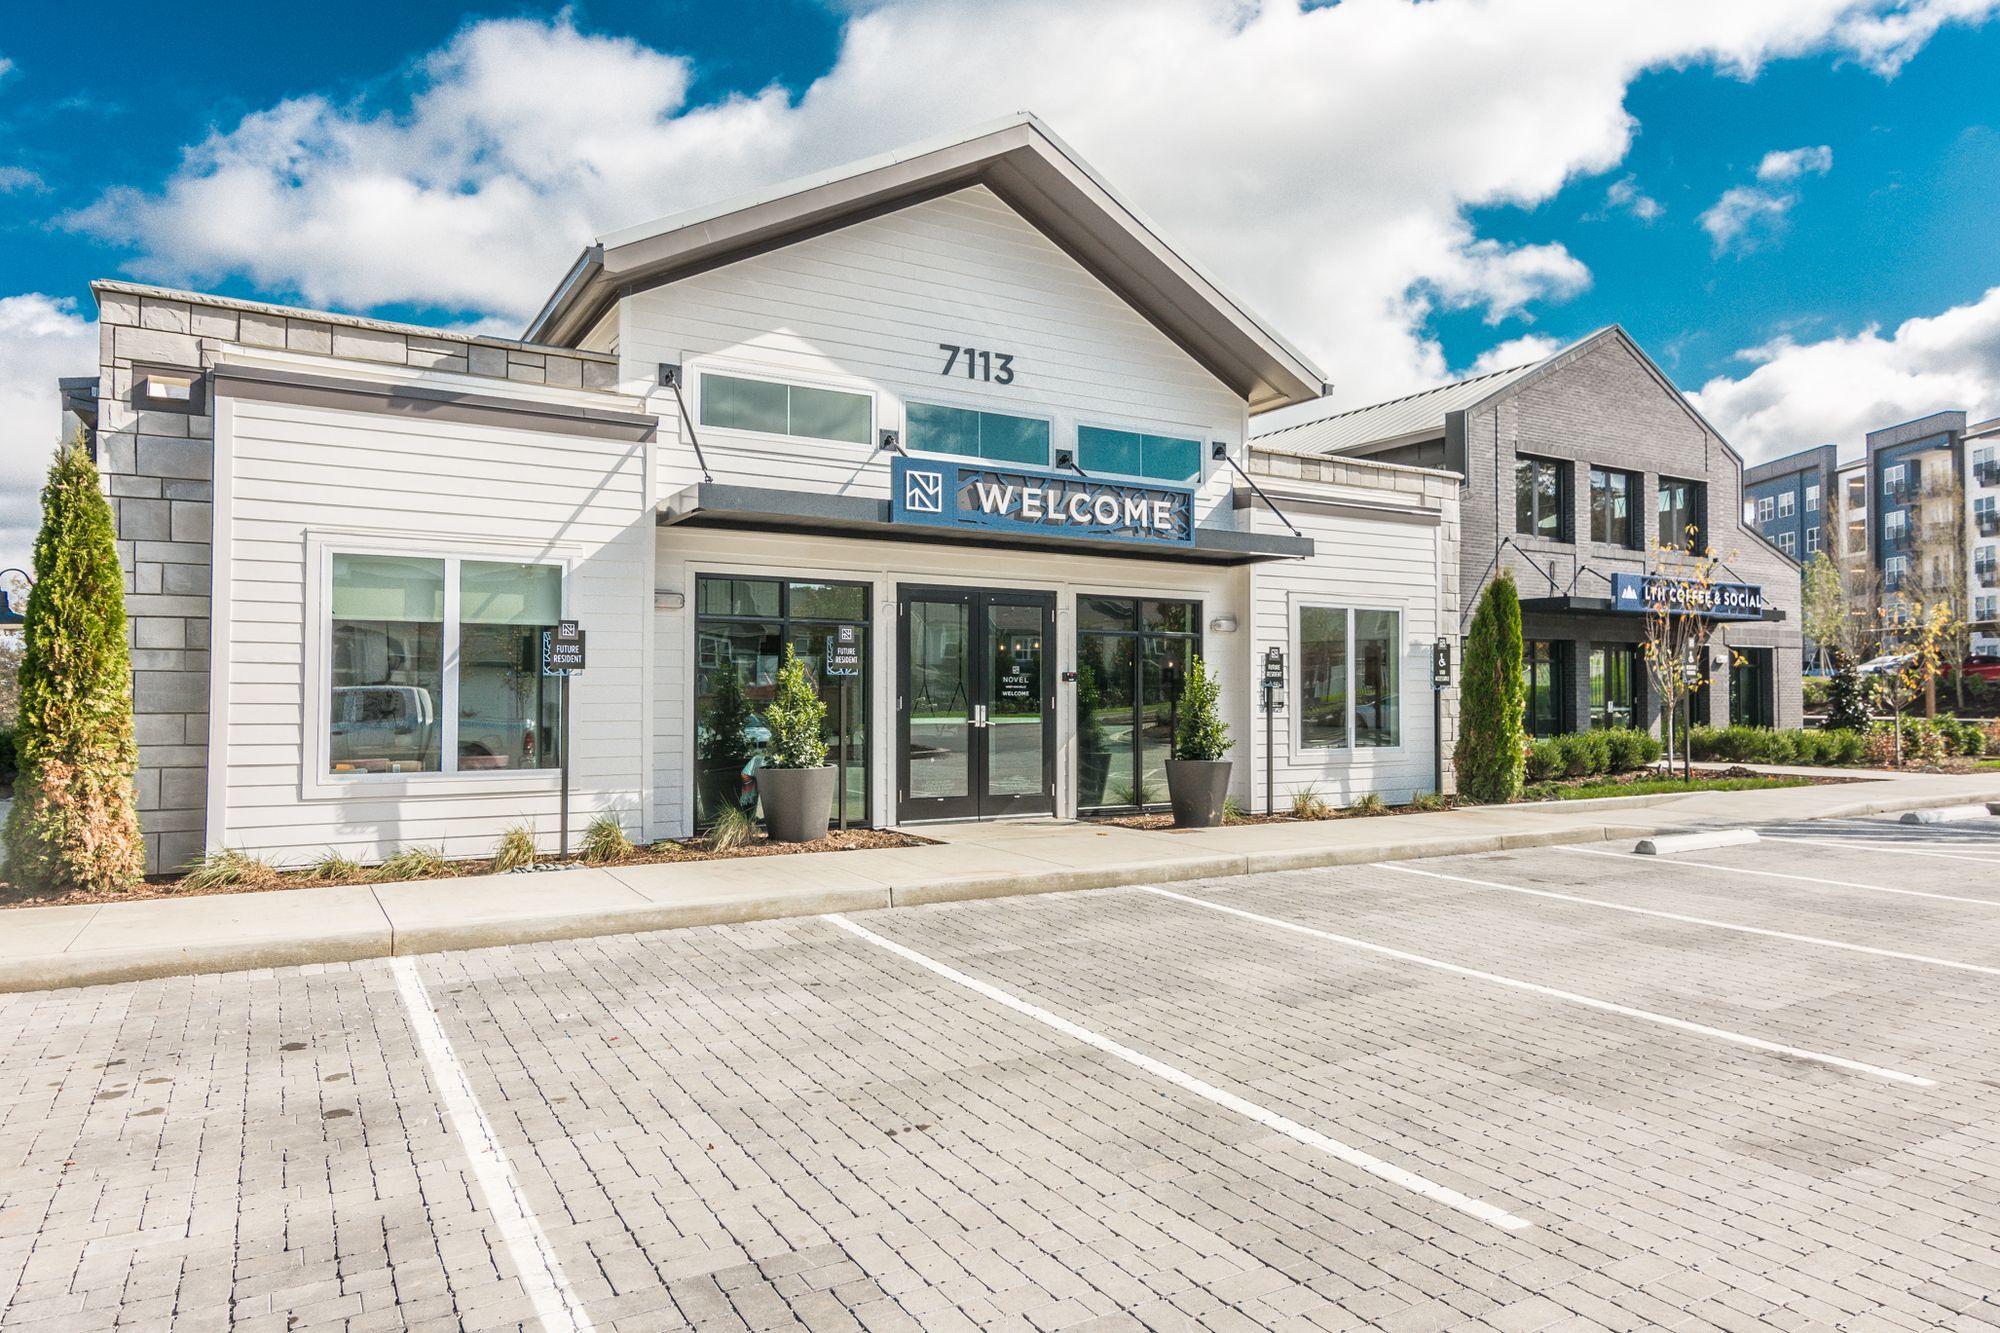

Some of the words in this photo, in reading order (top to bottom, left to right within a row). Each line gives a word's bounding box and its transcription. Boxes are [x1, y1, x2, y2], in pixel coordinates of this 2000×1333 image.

[939, 343, 1015, 385] 7113
[976, 482, 1172, 530] WELCOME
[1714, 591, 1722, 605] &
[1723, 592, 1762, 608] SOCIAL
[556, 644, 580, 654] FUTURE
[837, 647, 856, 656] FUTURE
[553, 654, 582, 663] RESIDENT
[834, 655, 858, 664] RESIDENT
